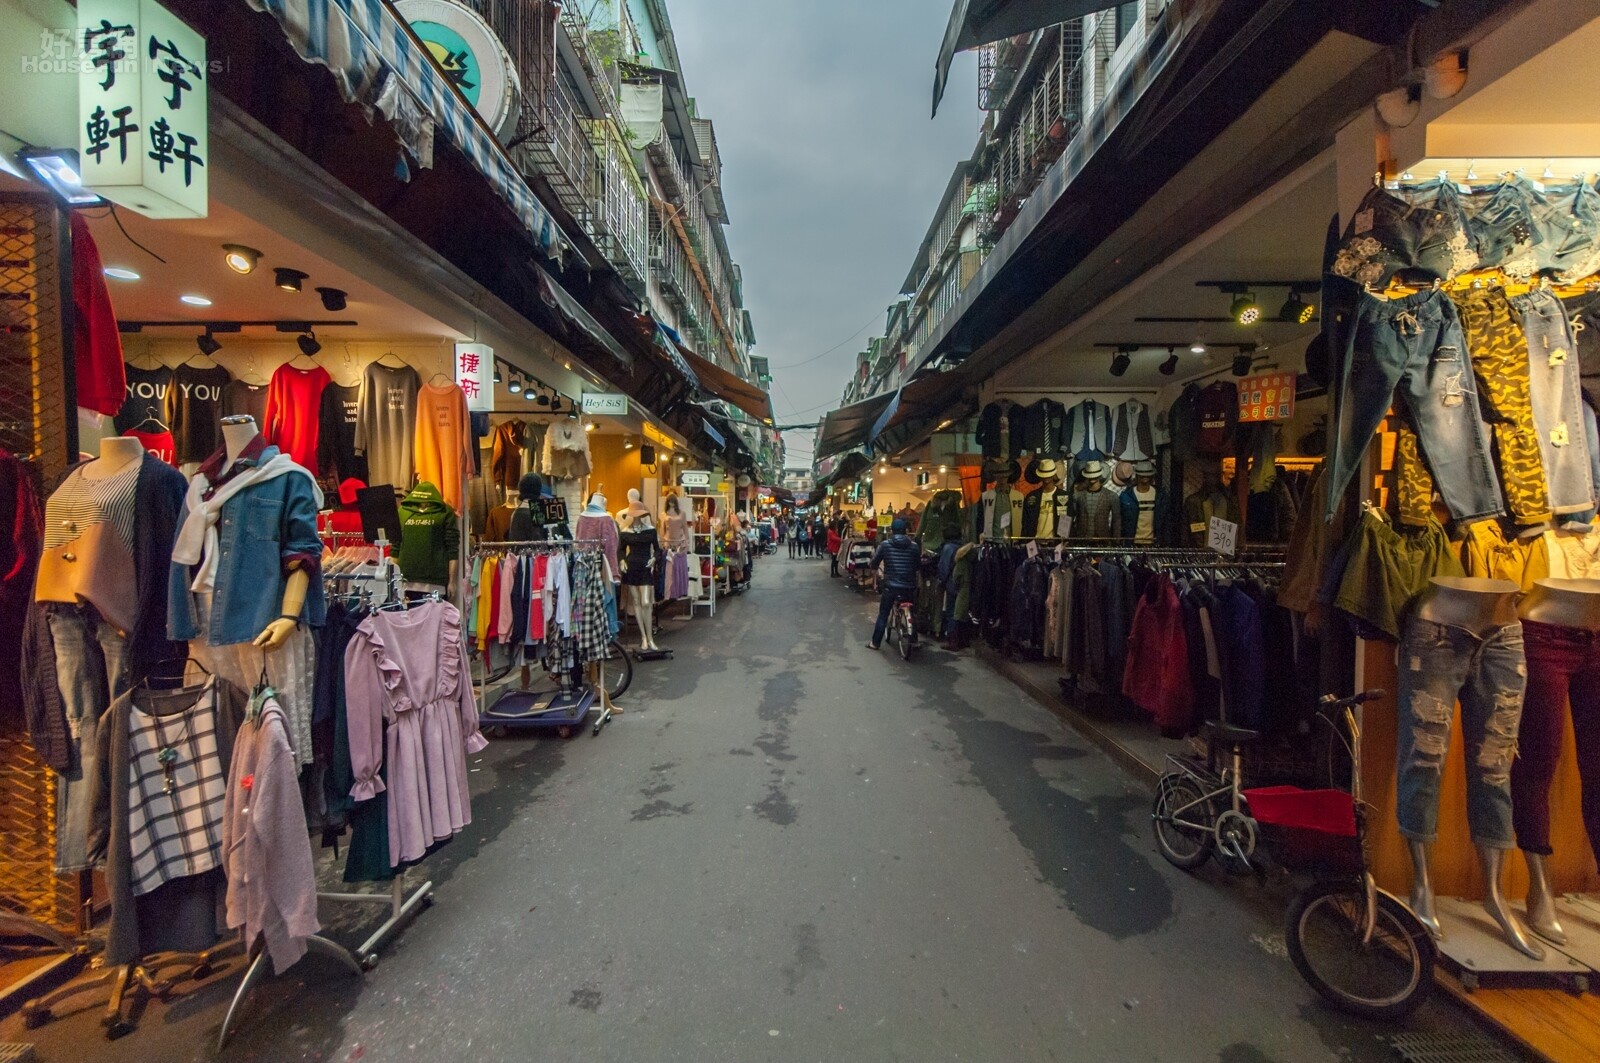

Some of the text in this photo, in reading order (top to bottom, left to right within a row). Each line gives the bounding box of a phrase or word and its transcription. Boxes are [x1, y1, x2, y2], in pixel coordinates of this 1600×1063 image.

[459, 352, 480, 399] 捷新
[126, 382, 167, 400] YOU
[180, 383, 220, 401] YOU
[585, 398, 604, 408] Hey!
[545, 503, 565, 521] 150
[1213, 532, 1232, 549] 390
